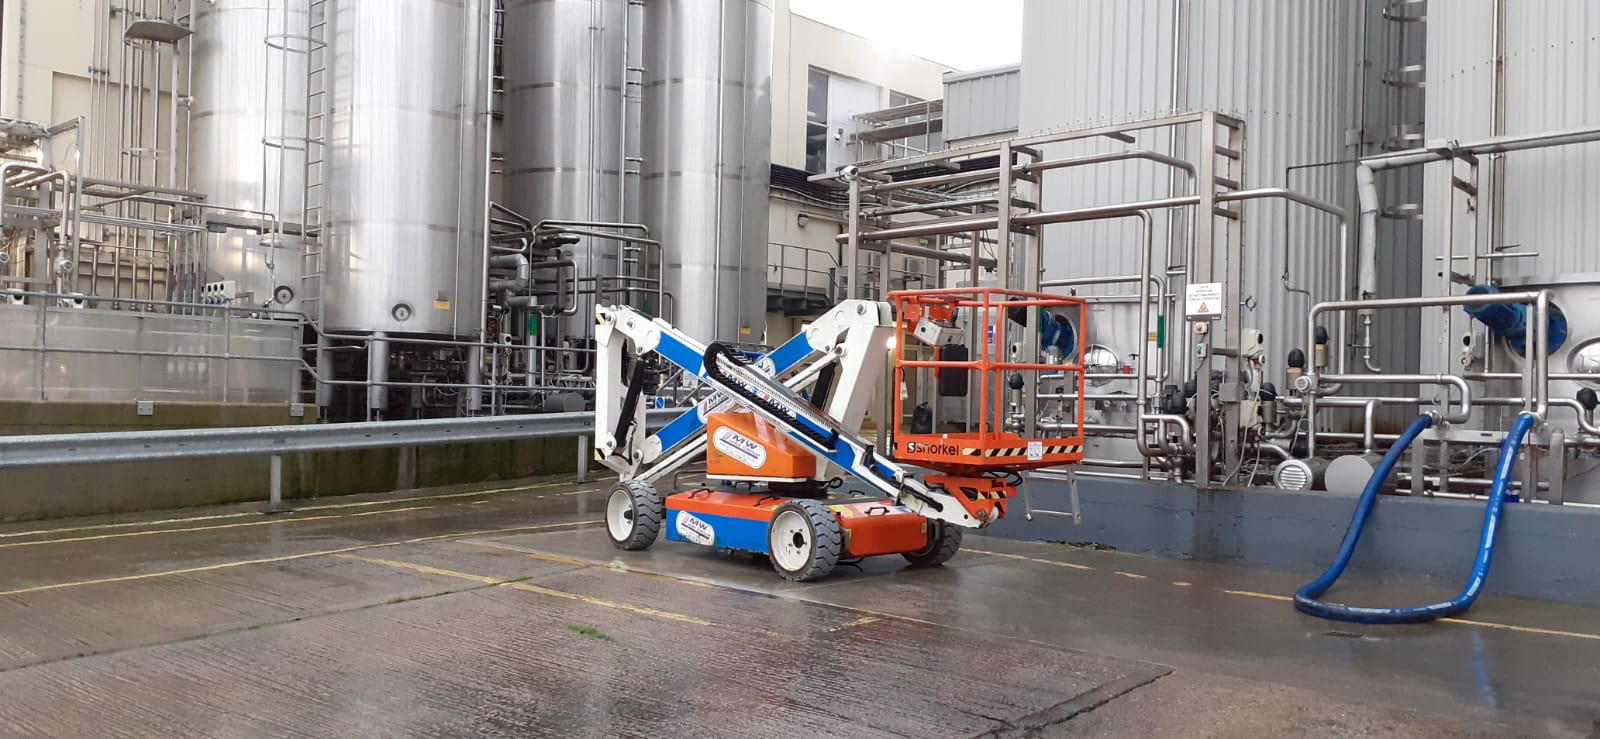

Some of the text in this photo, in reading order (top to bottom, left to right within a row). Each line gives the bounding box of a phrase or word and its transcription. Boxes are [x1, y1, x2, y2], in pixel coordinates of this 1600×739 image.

[732, 435, 757, 450] MW
[917, 444, 959, 456] snorkel
[690, 518, 708, 531] MW
